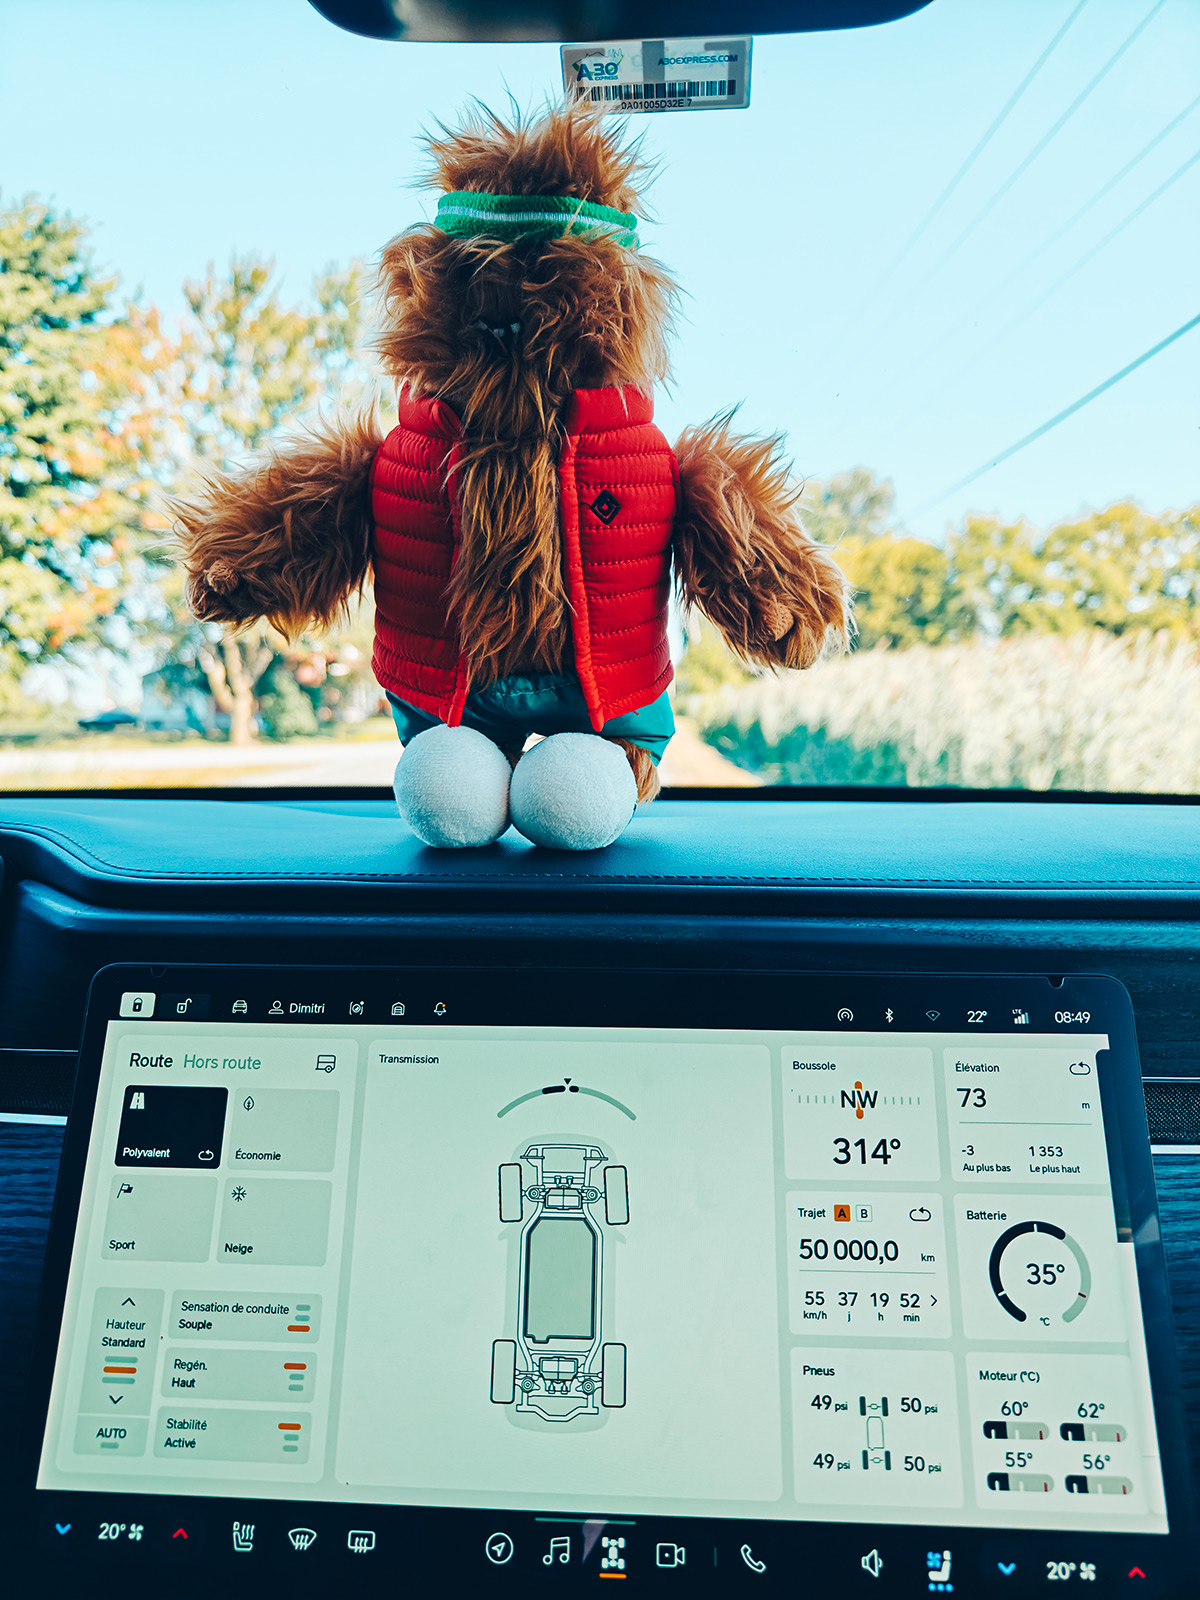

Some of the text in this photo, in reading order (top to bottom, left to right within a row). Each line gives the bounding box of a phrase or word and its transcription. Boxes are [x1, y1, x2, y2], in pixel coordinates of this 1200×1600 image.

[289, 1003, 325, 1014] Dimitri
[1055, 1012, 1091, 1024] 08:49
[129, 1053, 173, 1068] Route
[183, 1054, 261, 1070] Hors route
[379, 1054, 439, 1065] Transmission
[793, 1061, 836, 1071] Boussole
[956, 1062, 1000, 1073] Élévation
[840, 1090, 878, 1108] NW
[956, 1088, 987, 1108] 73
[123, 1147, 170, 1159] Polyvalent
[235, 1150, 281, 1161] Économie
[833, 1138, 901, 1164] 314°
[962, 1145, 975, 1156] -3
[963, 1163, 1011, 1174] Au plus bas
[1030, 1164, 1080, 1175] Le plus haut
[798, 1208, 867, 1219] Trajet A B
[967, 1211, 1007, 1220] Batterie
[109, 1240, 135, 1250] Sport
[224, 1243, 253, 1255] Neige
[921, 1253, 935, 1262] km
[1026, 1264, 1065, 1285] 35°
[805, 1291, 920, 1308] 55 37 19 52
[181, 1302, 289, 1315] Sensation de conduite
[803, 1310, 827, 1321] km/h
[847, 1313, 851, 1322] j
[903, 1313, 920, 1321] min
[106, 1319, 145, 1330] Hauteur
[179, 1319, 212, 1331] Souple
[102, 1337, 145, 1348] Standard
[803, 1366, 835, 1376] Pneus
[980, 1371, 1017, 1381] Moteur
[172, 1378, 195, 1388] Haut
[811, 1396, 848, 1411] 49 psi
[901, 1398, 937, 1414] 50 psi
[1001, 1402, 1028, 1416] 60°
[1077, 1403, 1105, 1418] 62°
[167, 1419, 207, 1430] Stabilité
[96, 1428, 126, 1439] AUTO
[164, 1437, 196, 1448] Activé
[813, 1454, 850, 1471] 49 psi
[904, 1456, 941, 1473] 50 psi
[1005, 1453, 1033, 1467] 55°
[1083, 1455, 1110, 1469] 56°
[98, 1523, 126, 1540] 20°
[1047, 1562, 1075, 1580] 20°
